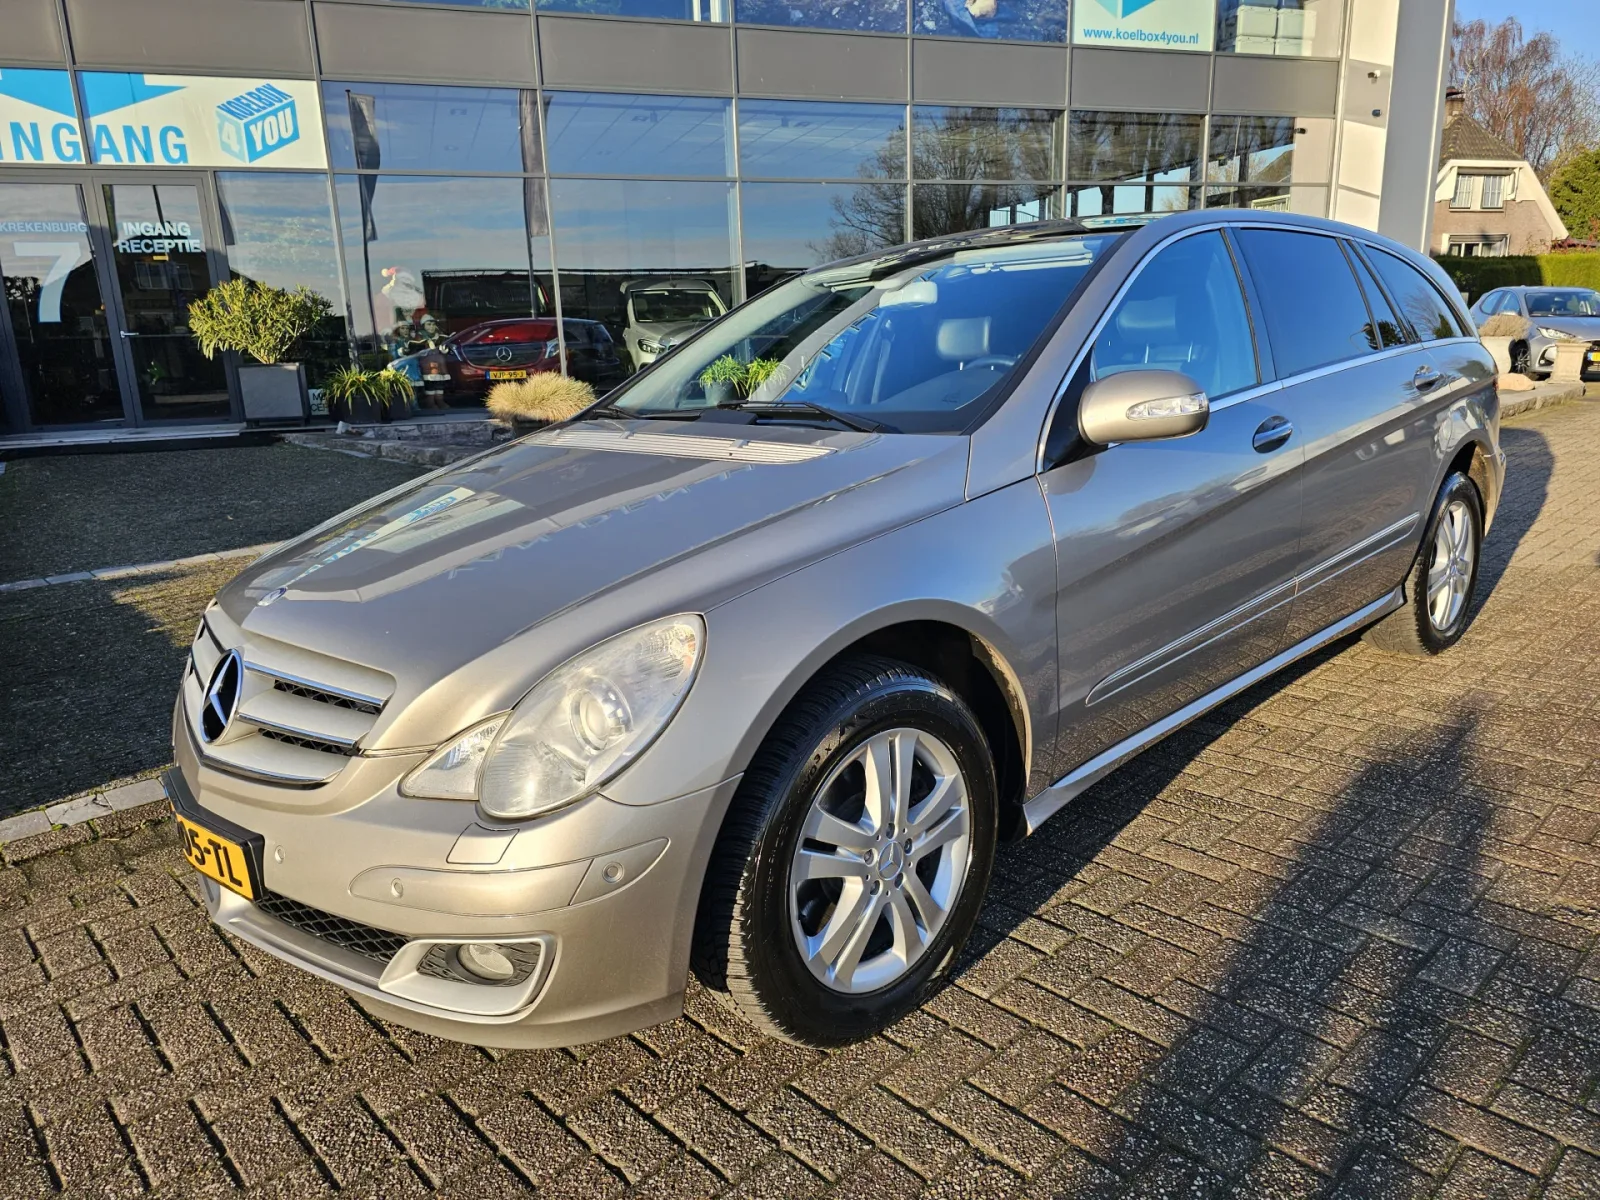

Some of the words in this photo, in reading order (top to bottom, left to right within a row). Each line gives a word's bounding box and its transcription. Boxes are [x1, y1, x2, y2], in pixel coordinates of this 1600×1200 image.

[1083, 27, 1199, 45] www.koelbox4you.nl
[216, 83, 293, 120] KOELBOX
[221, 121, 241, 155] 4
[249, 107, 294, 152] YOU
[0, 222, 88, 232] KREKENBURG
[122, 222, 191, 236] INGANG
[118, 239, 202, 253] RECEPTIE
[13, 242, 81, 323] 7
